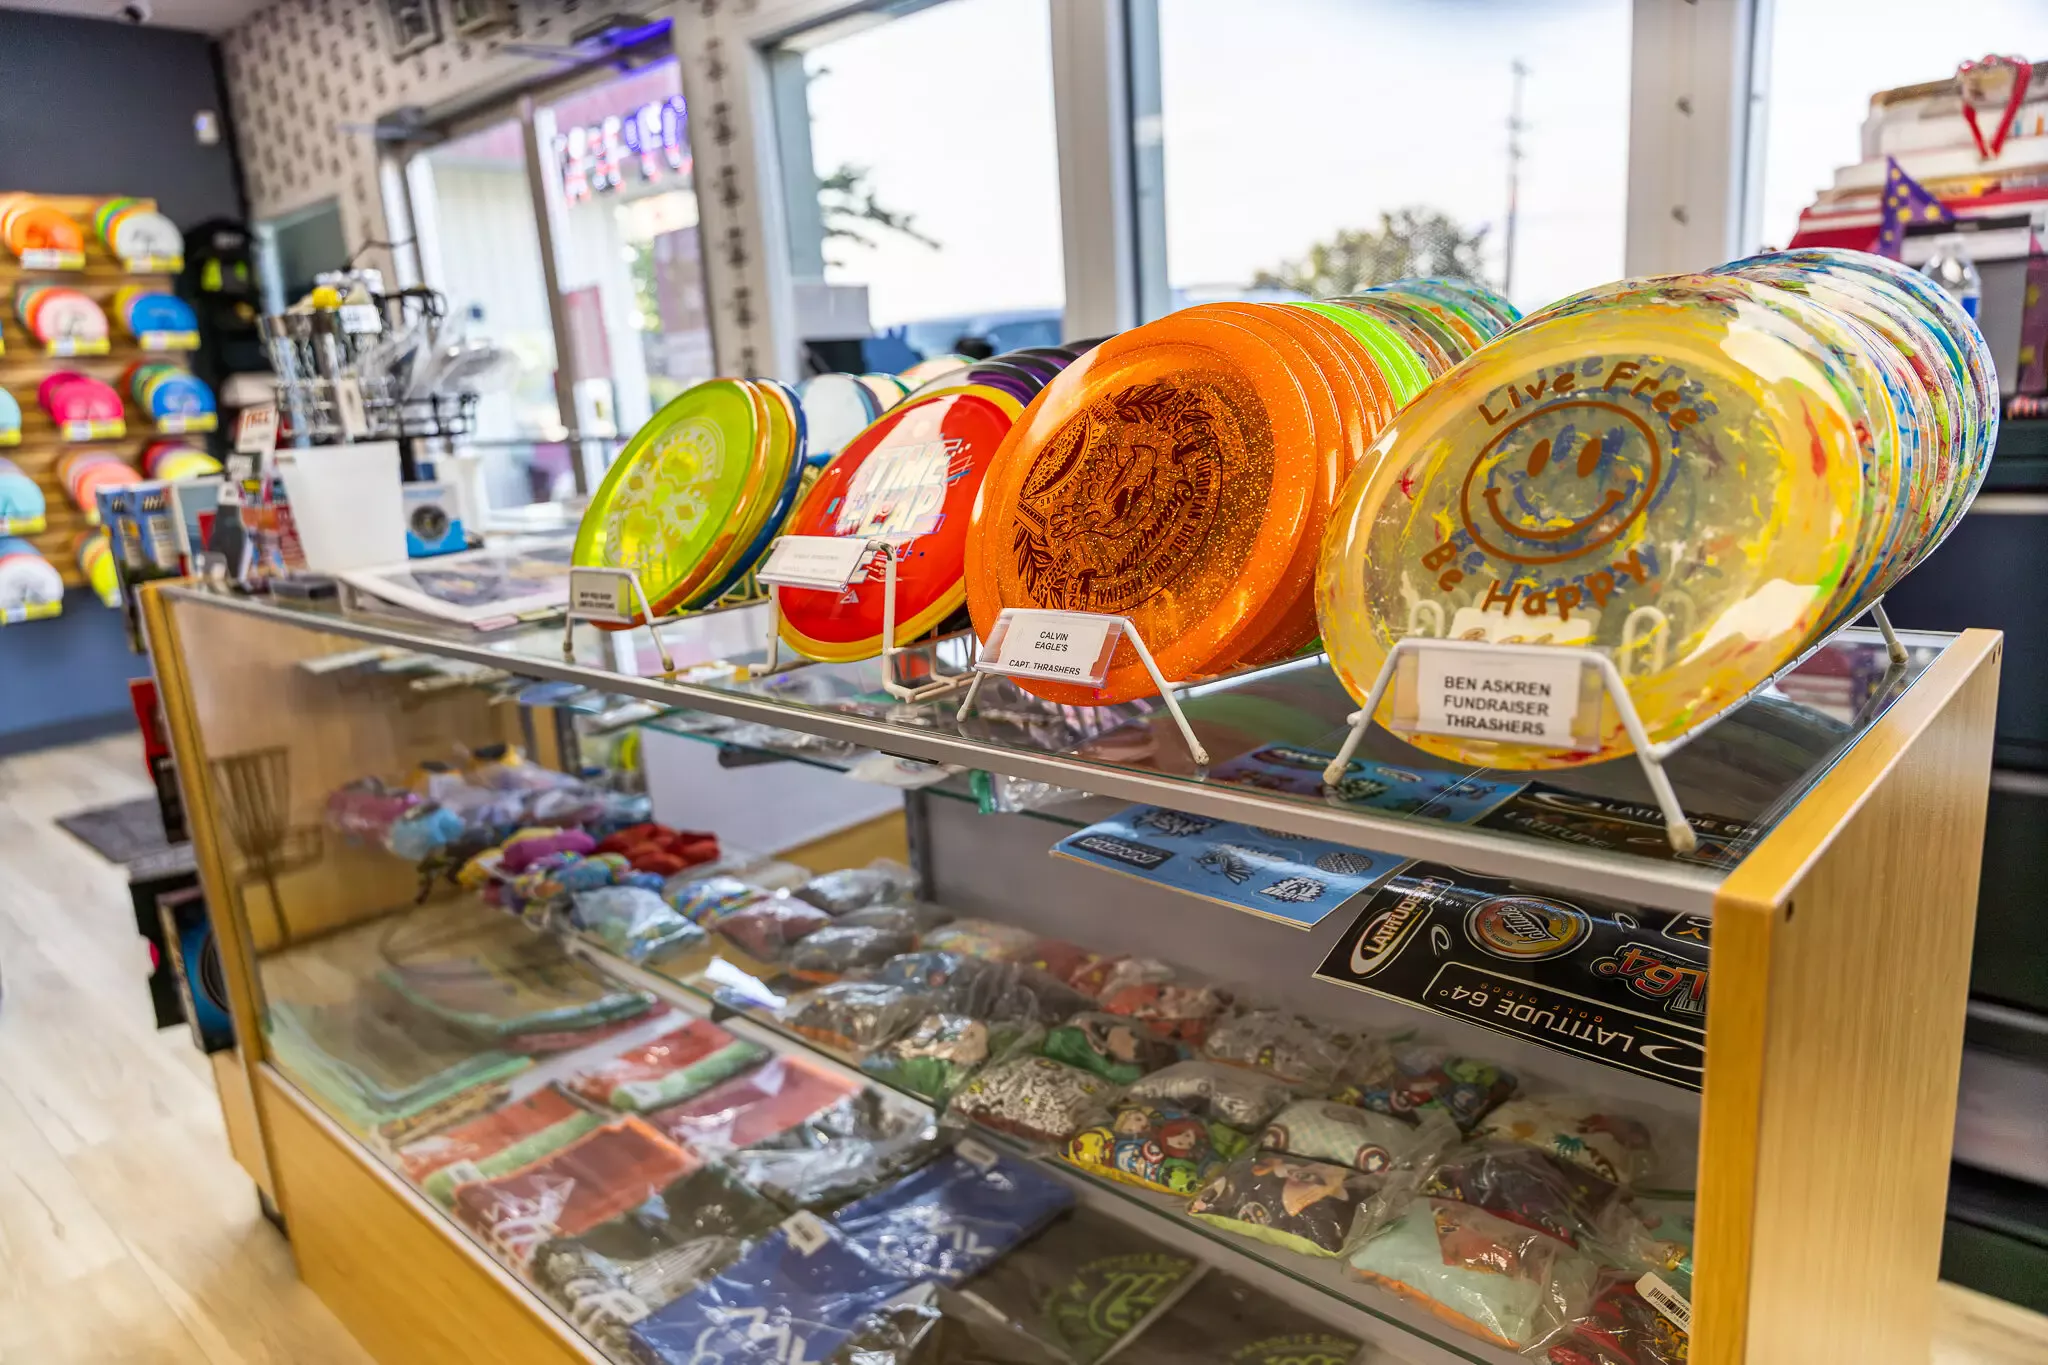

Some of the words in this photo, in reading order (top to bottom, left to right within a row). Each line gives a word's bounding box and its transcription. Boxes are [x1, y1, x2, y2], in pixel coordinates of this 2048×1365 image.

[1478, 371, 1576, 426] Live
[1603, 361, 1698, 431] Free
[1169, 523, 1197, 555] DISC
[1421, 541, 1464, 592] Be
[1480, 548, 1648, 621] Happy
[1035, 641, 1069, 652] EAGLE'S
[1039, 630, 1069, 642] CALVIN
[1008, 659, 1031, 669] CAPT.
[1033, 662, 1081, 676] THRASHERS
[1444, 675, 1477, 691] BEN
[1480, 679, 1552, 697] ASKREN
[1443, 694, 1550, 717] FUNDRAISER
[1445, 713, 1546, 736] THRASHERS
[1606, 803, 1717, 830] LATITDE
[1365, 889, 1422, 954] LATITUDE
[1497, 904, 1560, 945] Latitude
[1480, 982, 1538, 1004] DISCS
[1494, 998, 1635, 1052] LATITUDE
[1553, 1004, 1603, 1023] GOLF
